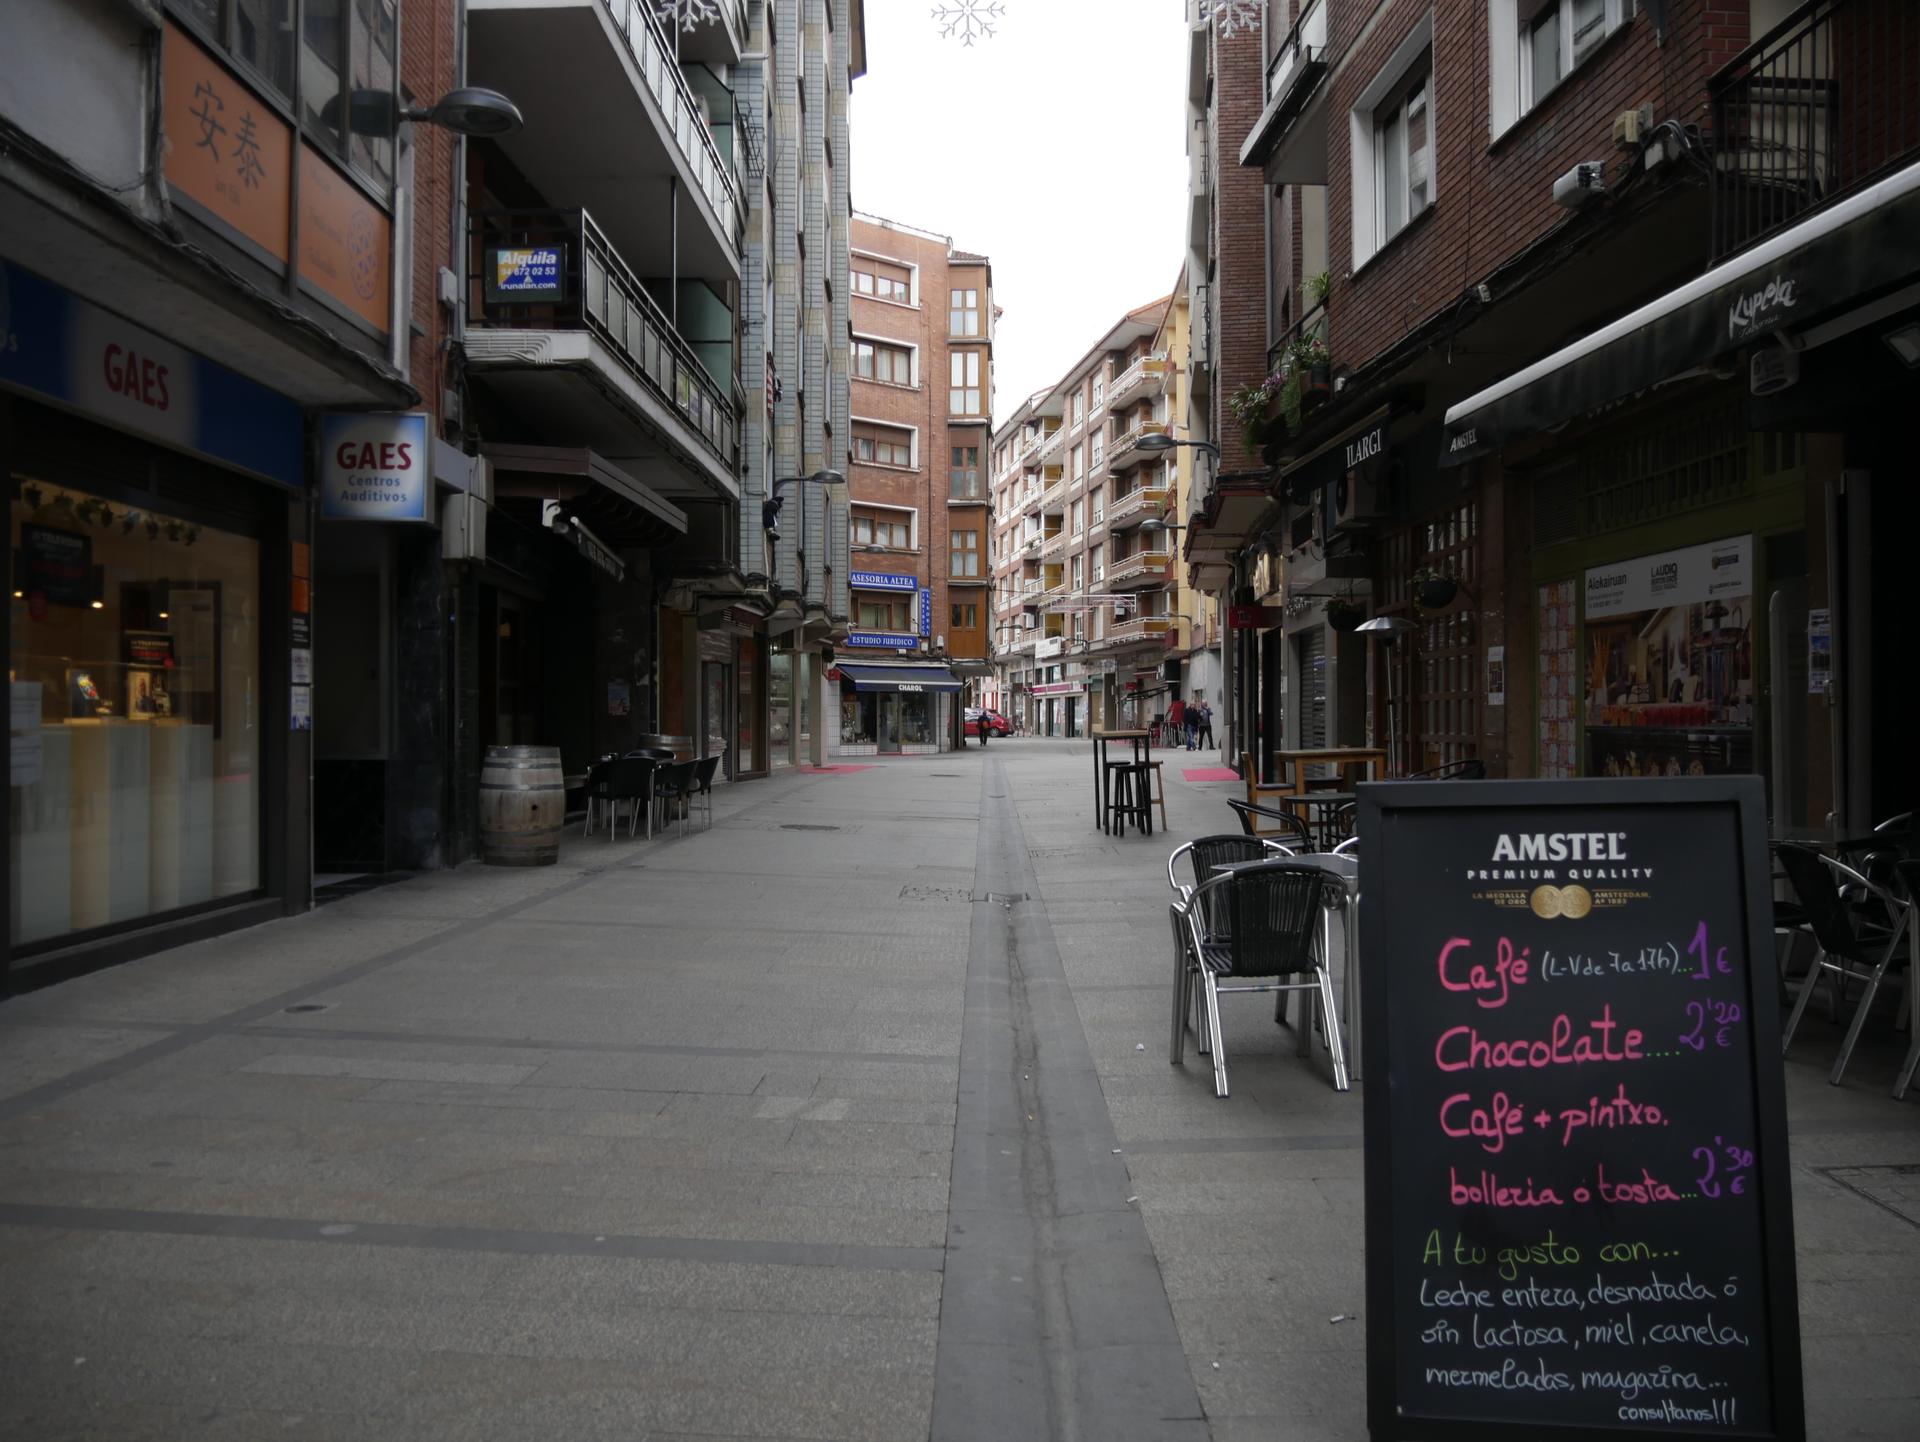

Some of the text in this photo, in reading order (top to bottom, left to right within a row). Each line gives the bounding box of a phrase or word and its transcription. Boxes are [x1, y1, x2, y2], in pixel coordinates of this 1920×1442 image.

[502, 251, 557, 268] Alquila
[513, 267, 530, 276] 672
[532, 267, 543, 276] 02
[545, 267, 556, 276] 53
[104, 343, 169, 411] GAES
[1345, 427, 1383, 470] ILARGI
[1449, 427, 1478, 453] AMSTEL
[336, 441, 412, 471] GAES
[348, 474, 401, 487] Centros
[341, 490, 407, 502] Auditivos
[851, 573, 914, 587] ASESORIA ALTEA
[1587, 574, 1628, 591] Alokairuan
[852, 636, 913, 646] ESTUDIO JURIDICO
[898, 684, 923, 692] CHAROL
[1491, 832, 1627, 861] AMSTEL
[1467, 868, 1653, 880] PREMIUM QUALITY
[1438, 936, 1530, 1008] Café
[1440, 1092, 1524, 1153] Café
[1559, 1080, 1670, 1147] pintxo.
[1423, 1229, 1441, 1266] A
[1453, 1233, 1486, 1265] tu
[1497, 1230, 1580, 1280] gusto
[1419, 1278, 1496, 1308] Leche
[1586, 1270, 1717, 1304] desnatada
[1420, 1320, 1459, 1344] sin
